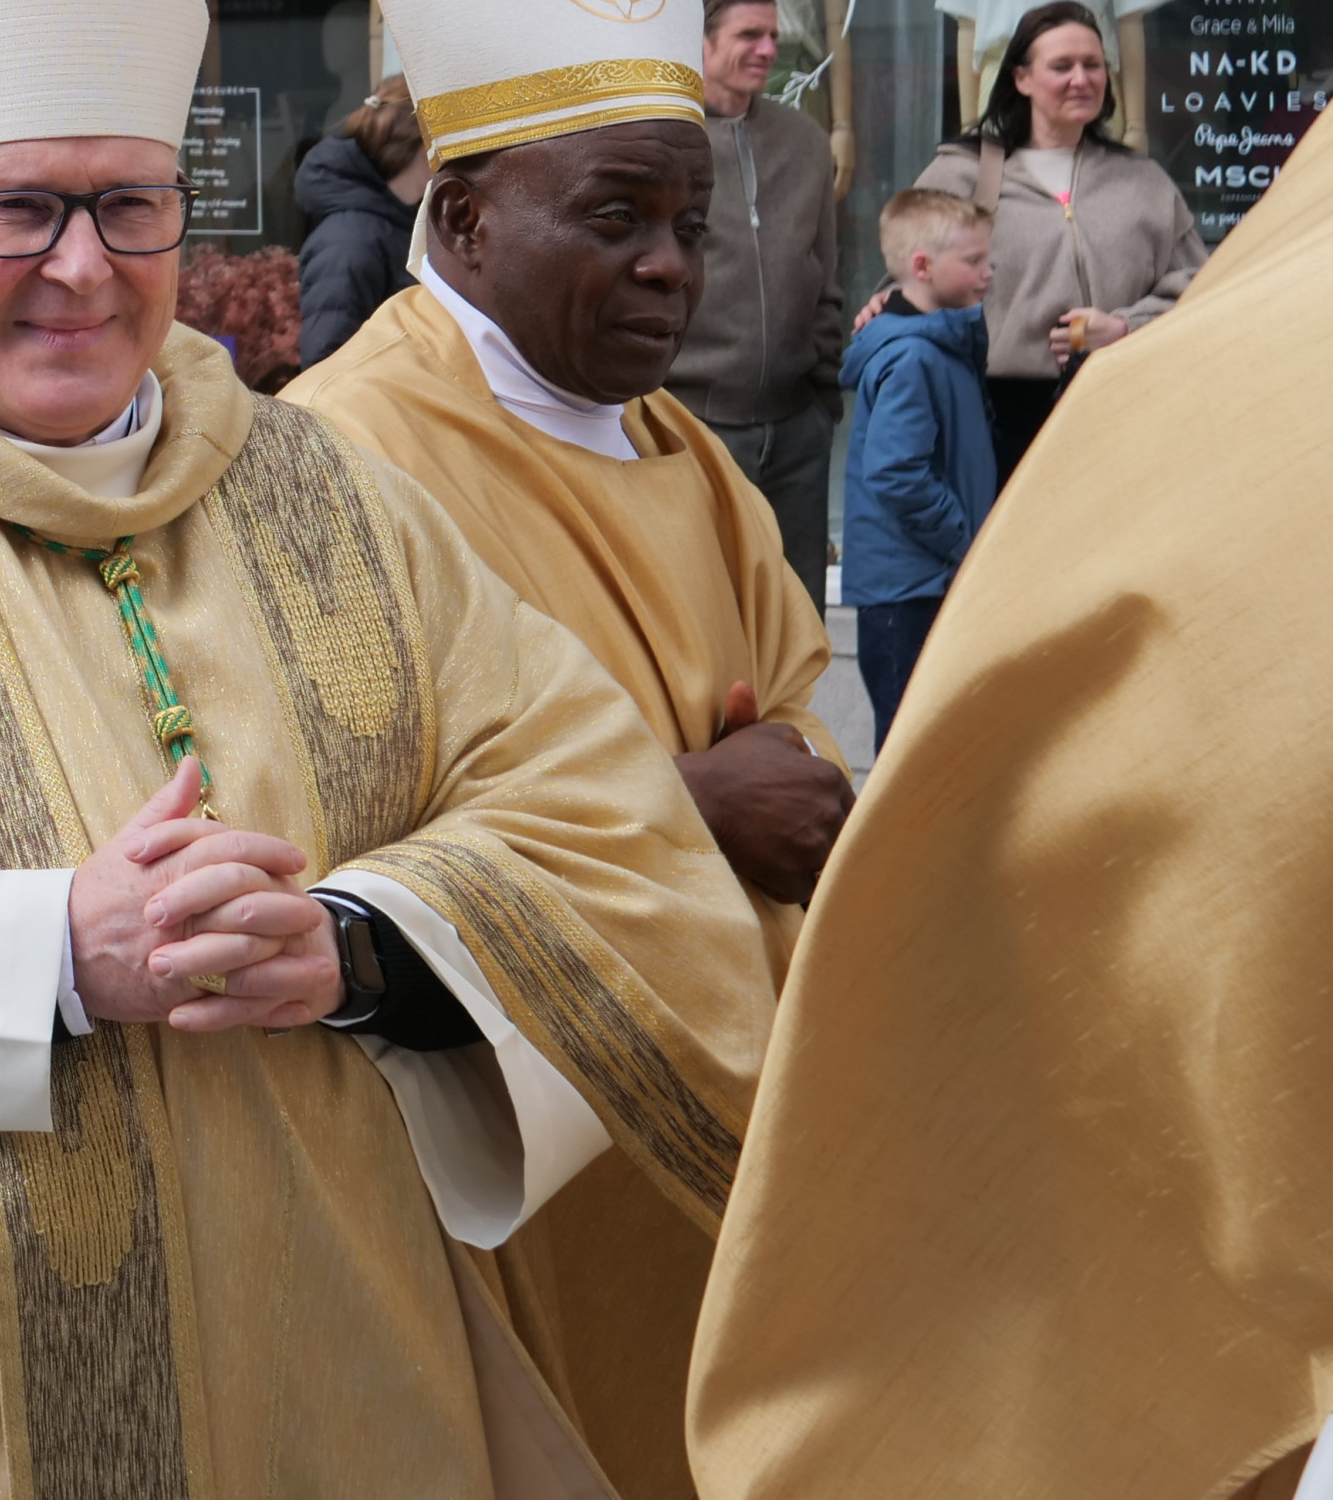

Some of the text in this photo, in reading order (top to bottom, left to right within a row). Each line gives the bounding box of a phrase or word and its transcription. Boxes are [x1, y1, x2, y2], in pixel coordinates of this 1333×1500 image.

[1190, 13, 1295, 36] Grace & Mila
[1190, 49, 1297, 76] NA-KD
[1161, 91, 1327, 113] LOAVIES
